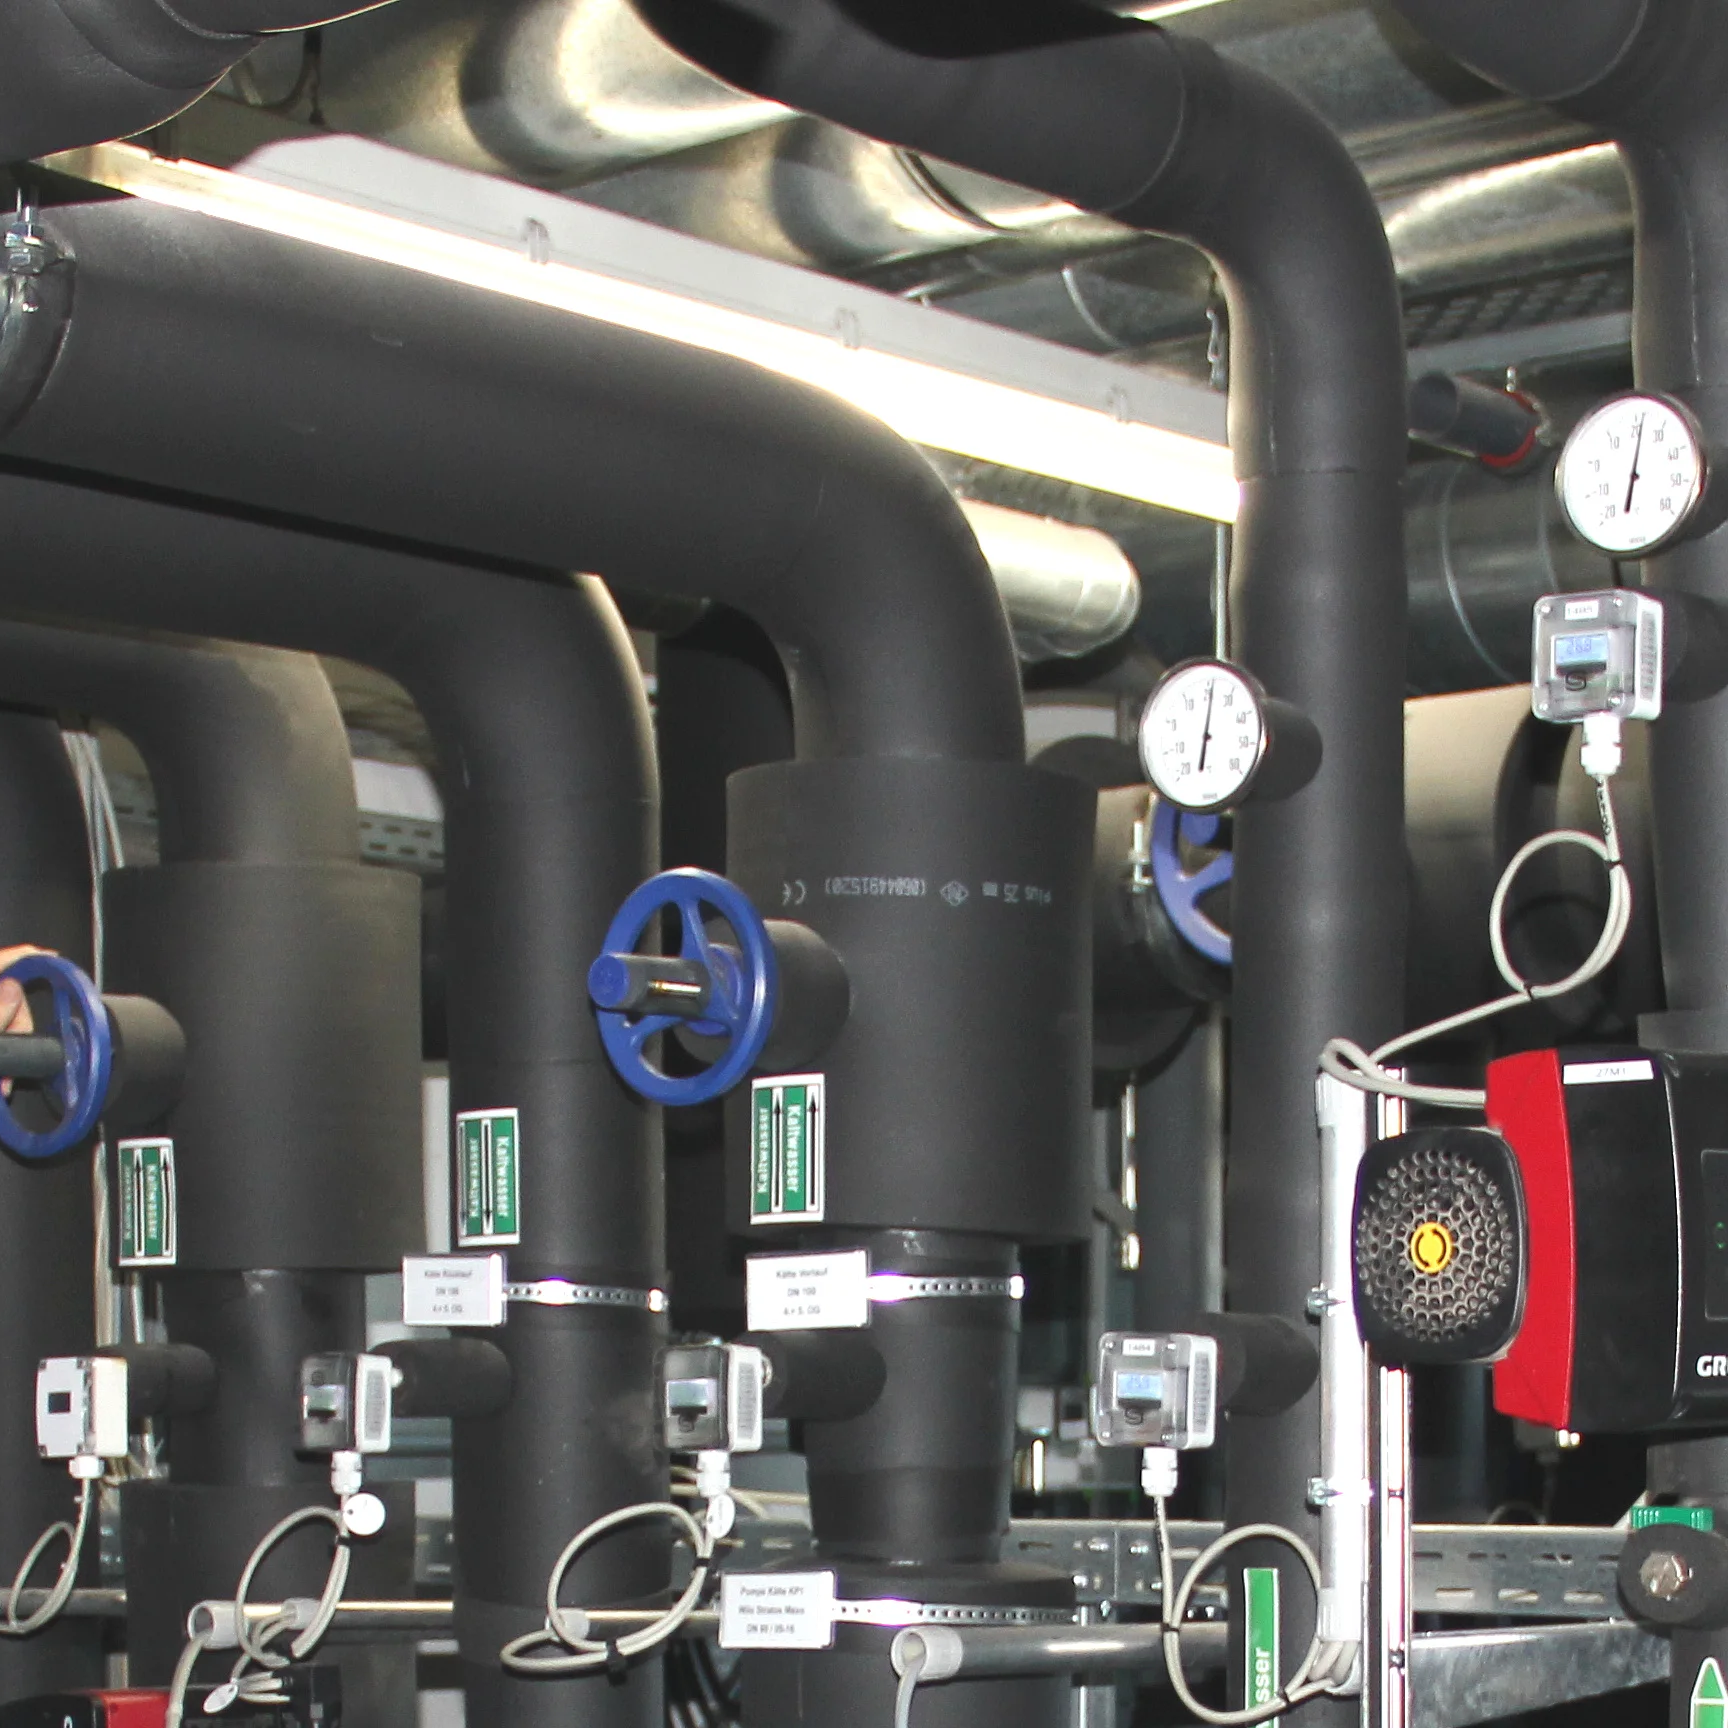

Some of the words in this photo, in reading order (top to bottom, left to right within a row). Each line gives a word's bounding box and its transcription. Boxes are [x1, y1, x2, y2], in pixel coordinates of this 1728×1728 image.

[1610, 436, 1620, 450] 10
[1653, 430, 1664, 443] 30
[1668, 447, 1679, 461] 40
[1671, 473, 1682, 488] 50
[1185, 697, 1194, 711] 10
[1223, 693, 1234, 707] 30
[1236, 711, 1247, 725] 40
[1238, 735, 1249, 748] 50
[758, 1107, 769, 1194] Kaltwasser
[786, 1104, 801, 1193] Kaltwasser
[496, 1135, 509, 1218] Kaltwasser
[146, 1163, 158, 1240] Kaltwasser
